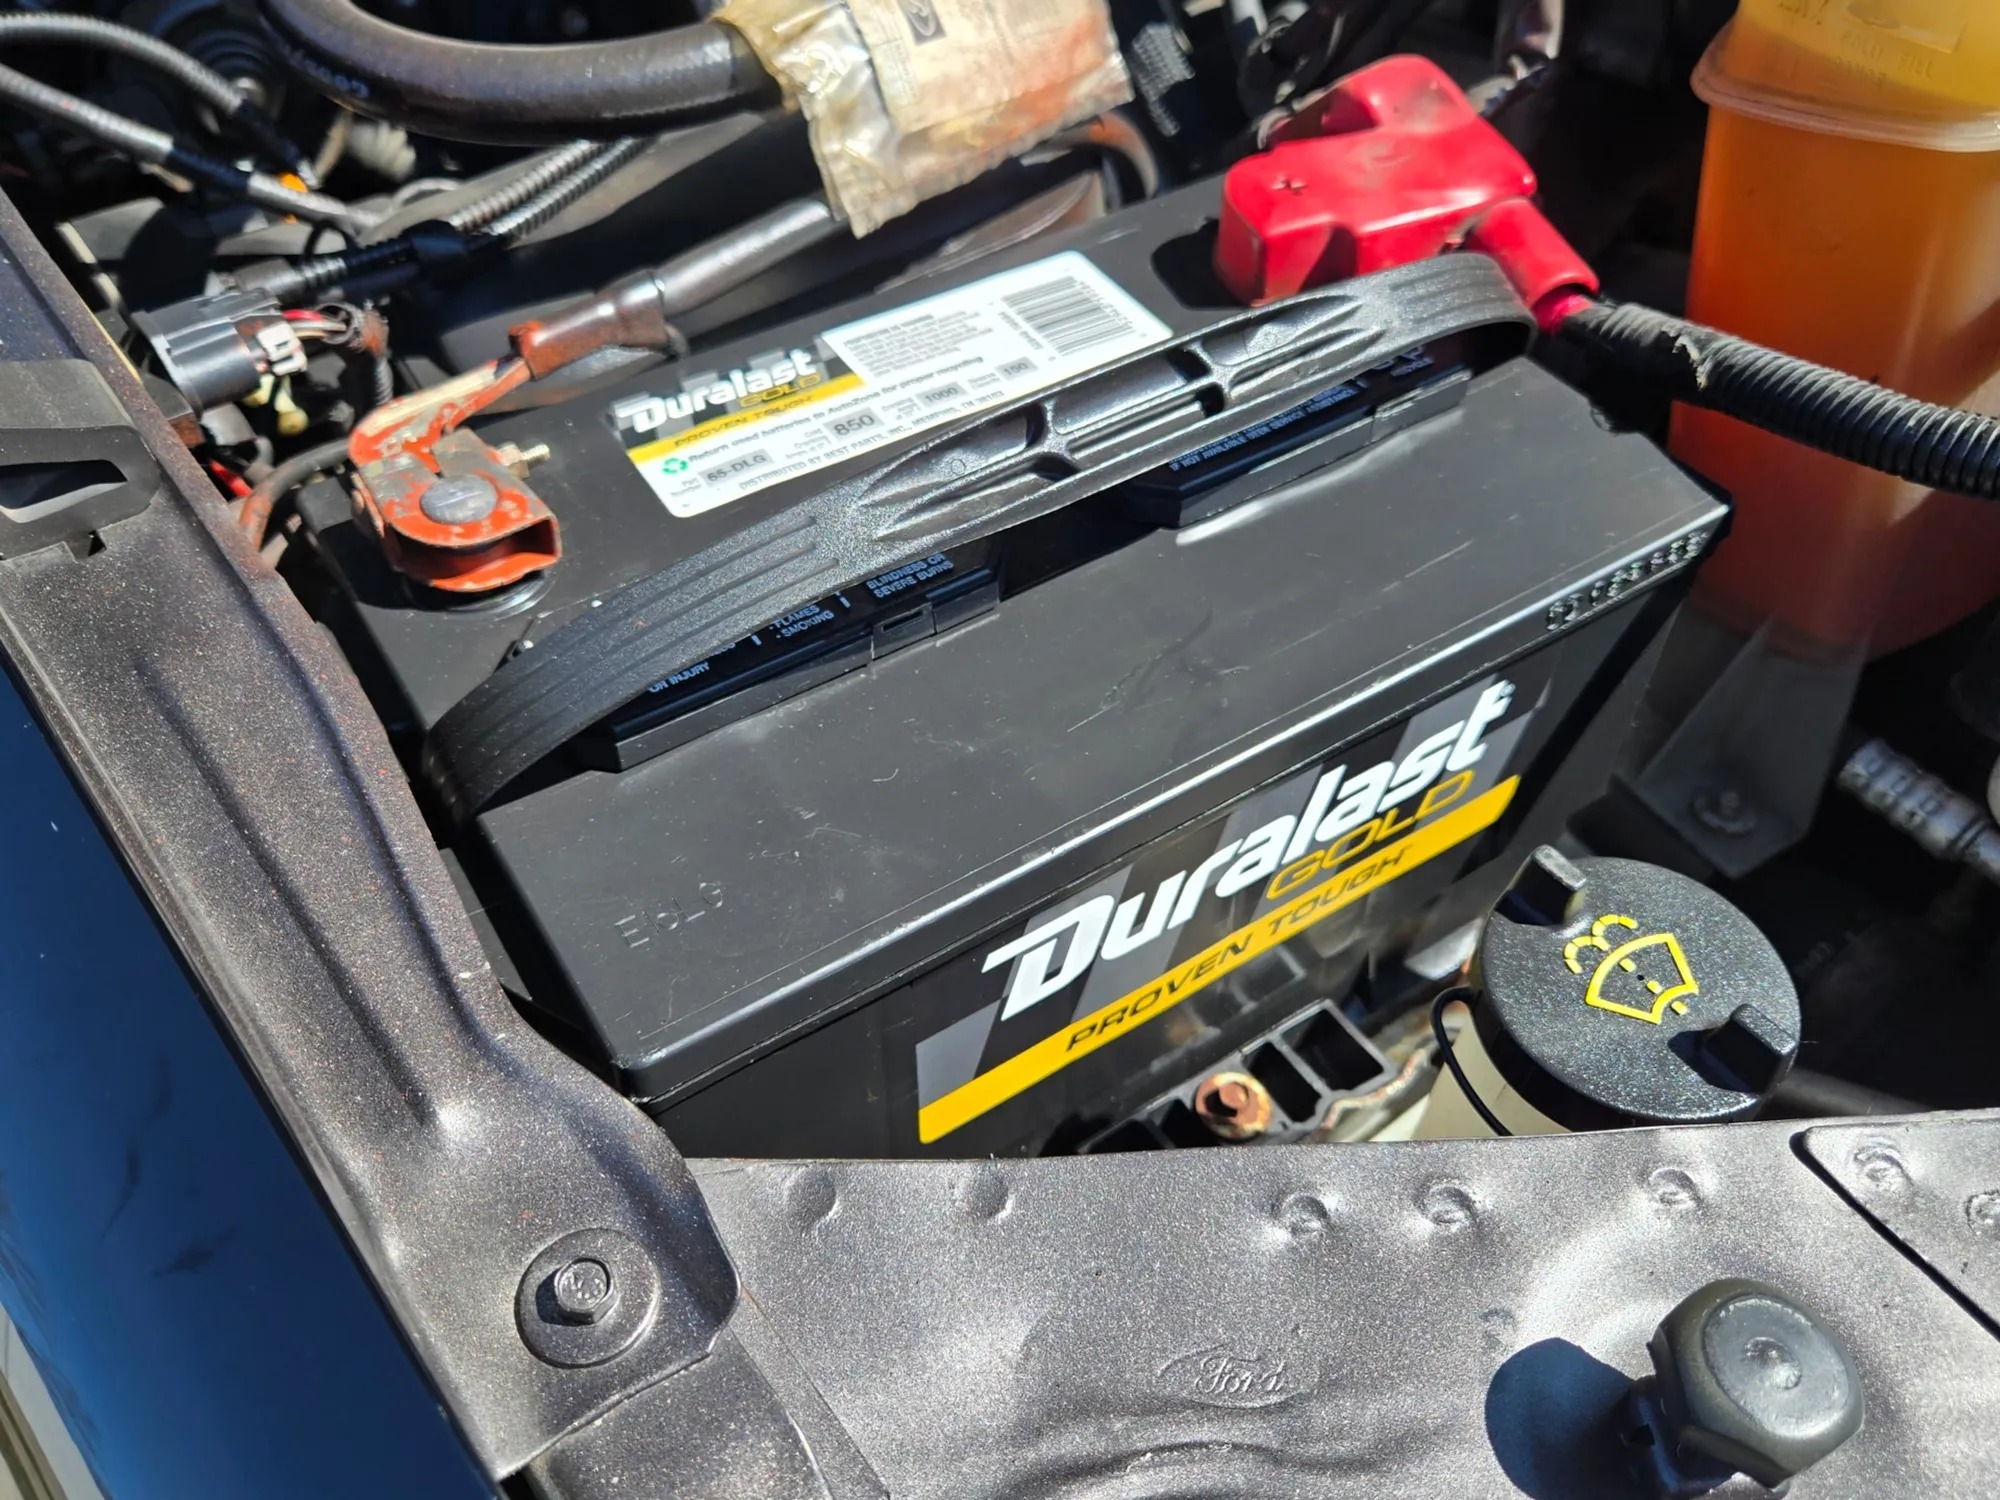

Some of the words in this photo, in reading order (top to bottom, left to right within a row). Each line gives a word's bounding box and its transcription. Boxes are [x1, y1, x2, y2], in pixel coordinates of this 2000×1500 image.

[1004, 362, 1028, 376] 150
[614, 348, 818, 434] Duralast
[740, 371, 821, 408] GOLD
[925, 387, 959, 402] 1000
[674, 416, 748, 448] PROVEN
[752, 394, 813, 420] TOUGH
[688, 444, 729, 462] Return
[731, 432, 760, 446] used
[762, 417, 811, 437] batteries
[813, 411, 825, 420] to
[828, 390, 881, 415] AutoZone
[881, 384, 897, 394] for
[900, 373, 934, 389] proper
[936, 356, 984, 375] recycling
[834, 414, 875, 436] 850
[1202, 435, 1248, 459] AVAILABLE
[707, 455, 766, 482] 65-DLG
[739, 461, 807, 490] DISTRIBUTED
[808, 455, 823, 465] BY
[824, 446, 850, 460] BEST
[866, 561, 928, 590] BLINDNESS
[927, 552, 946, 565] OR
[873, 576, 917, 598] SEVERE
[916, 560, 954, 581] BURNS
[774, 604, 820, 629] FLAMES
[781, 610, 835, 637] SMOKING
[648, 679, 669, 693] OR
[668, 661, 710, 685] INJURY
[982, 680, 1513, 1021] Duralast
[1265, 769, 1475, 901] GOLD
[1066, 933, 1254, 1054] PROVEN
[1268, 846, 1417, 941] TOUGH
[1194, 1355, 1287, 1395] Ford
